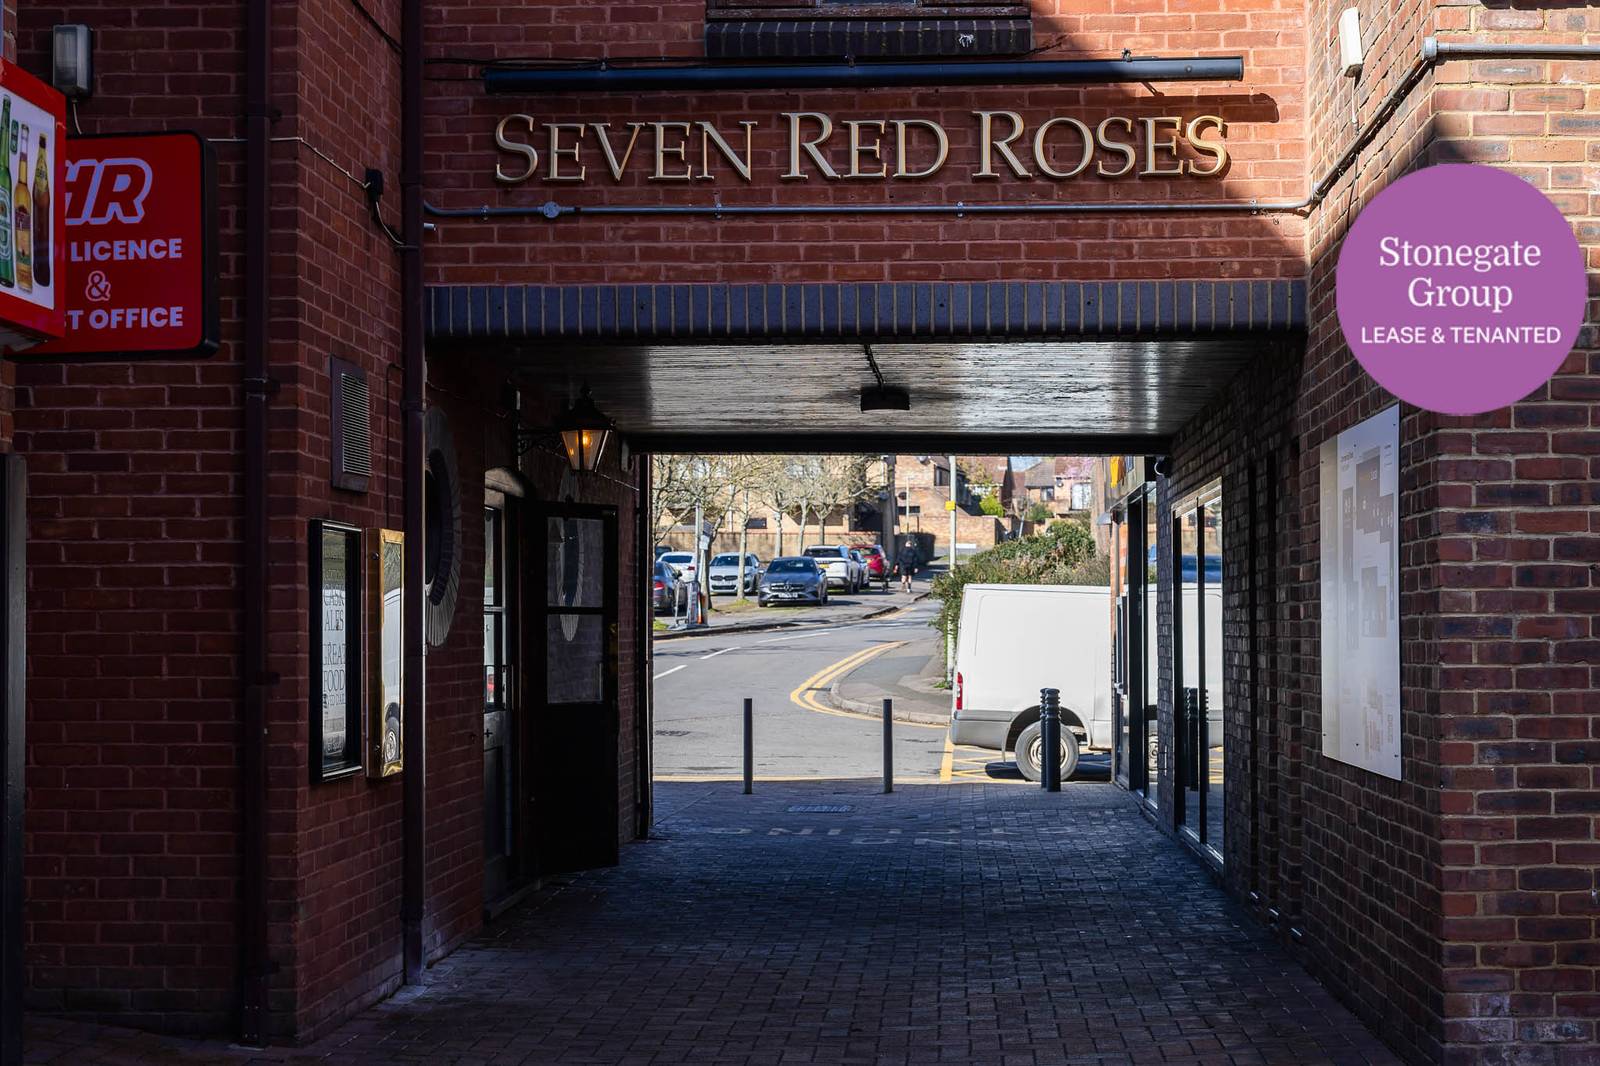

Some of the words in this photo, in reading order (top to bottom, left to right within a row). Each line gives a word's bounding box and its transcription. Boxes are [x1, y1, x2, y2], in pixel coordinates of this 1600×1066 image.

[495, 113, 758, 183] SEVEN
[780, 111, 949, 180] RED
[971, 110, 1231, 180] ROSES
[70, 238, 183, 262] LICENCE
[85, 270, 111, 302] &
[64, 309, 84, 330] T
[88, 306, 183, 329] OFFICE
[323, 669, 345, 692] FOOD
